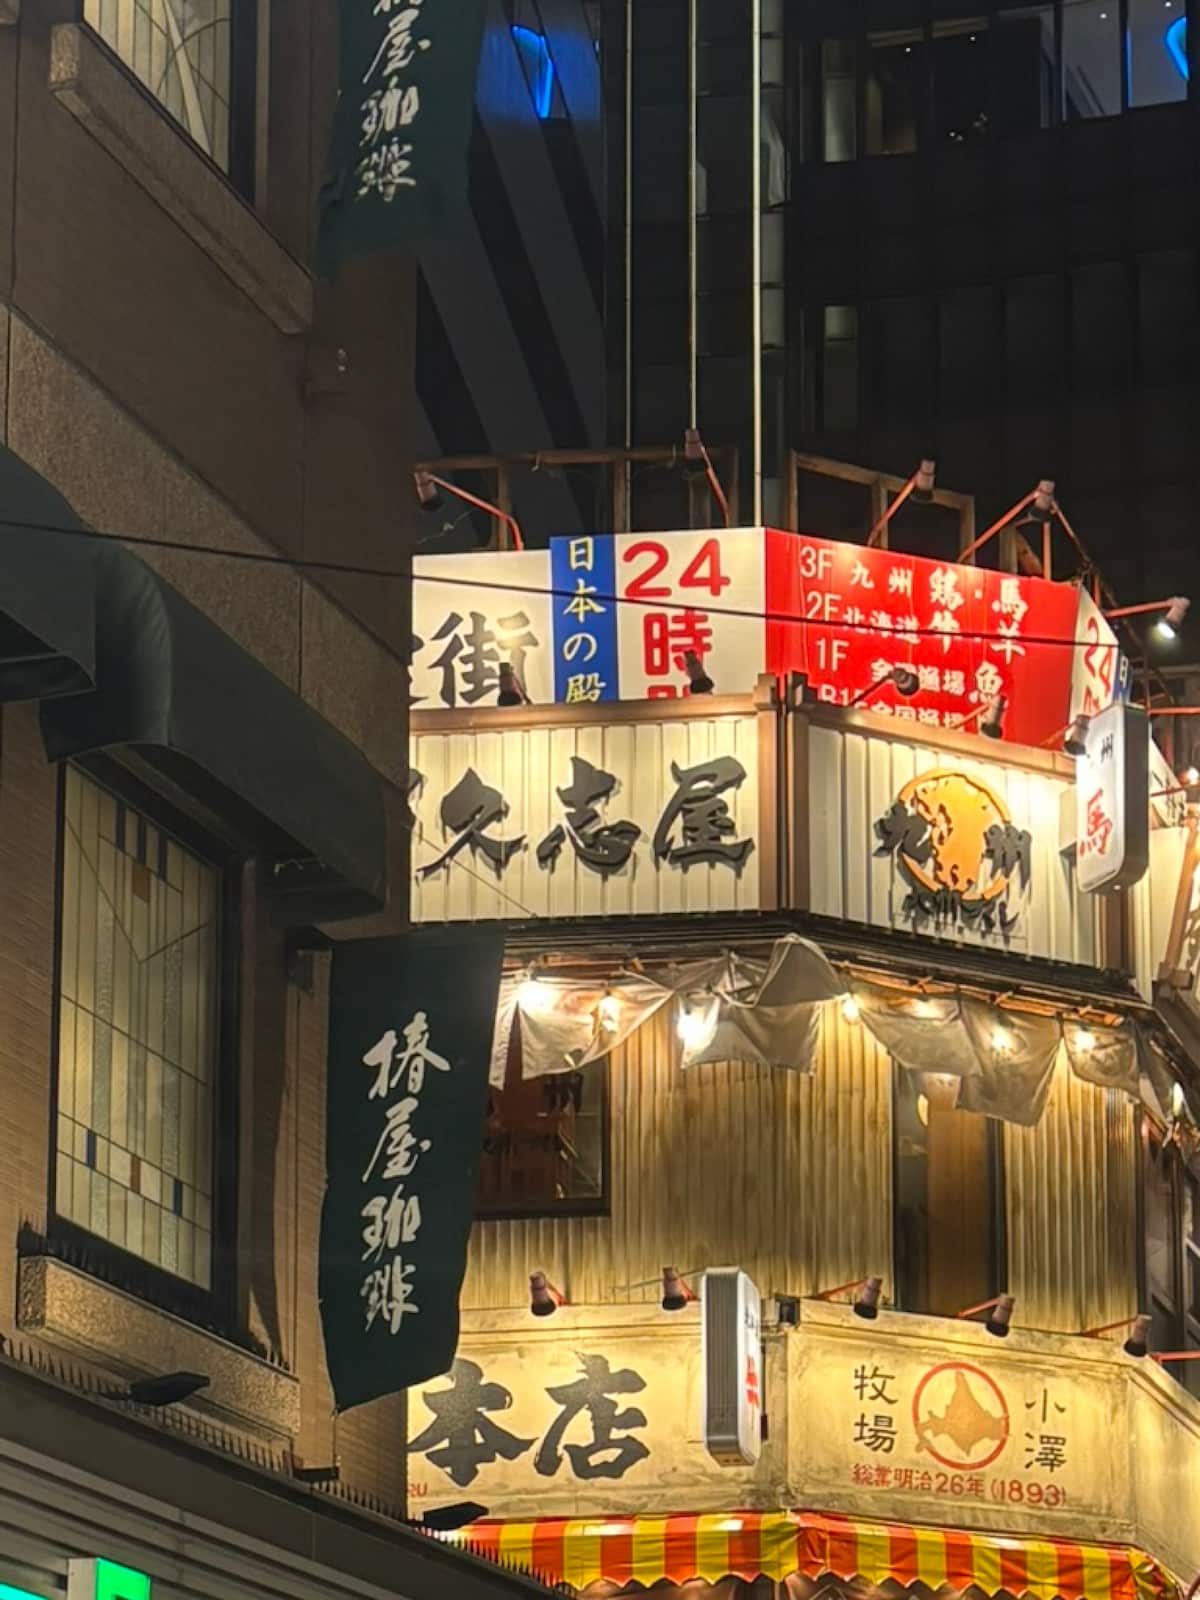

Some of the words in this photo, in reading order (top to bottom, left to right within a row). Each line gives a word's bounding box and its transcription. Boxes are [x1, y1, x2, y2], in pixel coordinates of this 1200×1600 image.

[354, 0, 431, 202] 屋珈琲
[801, 546, 834, 580] 3F
[850, 561, 914, 597] 九州
[807, 591, 842, 622] 2F
[400, 611, 539, 706] 街
[816, 638, 850, 672] 1F
[401, 755, 757, 888] 久志屋
[362, 1012, 451, 1335] 椿屋珈琲
[408, 1351, 651, 1487] 本店
[853, 1364, 898, 1455] 牧場
[1025, 1387, 1067, 1474] 小澤
